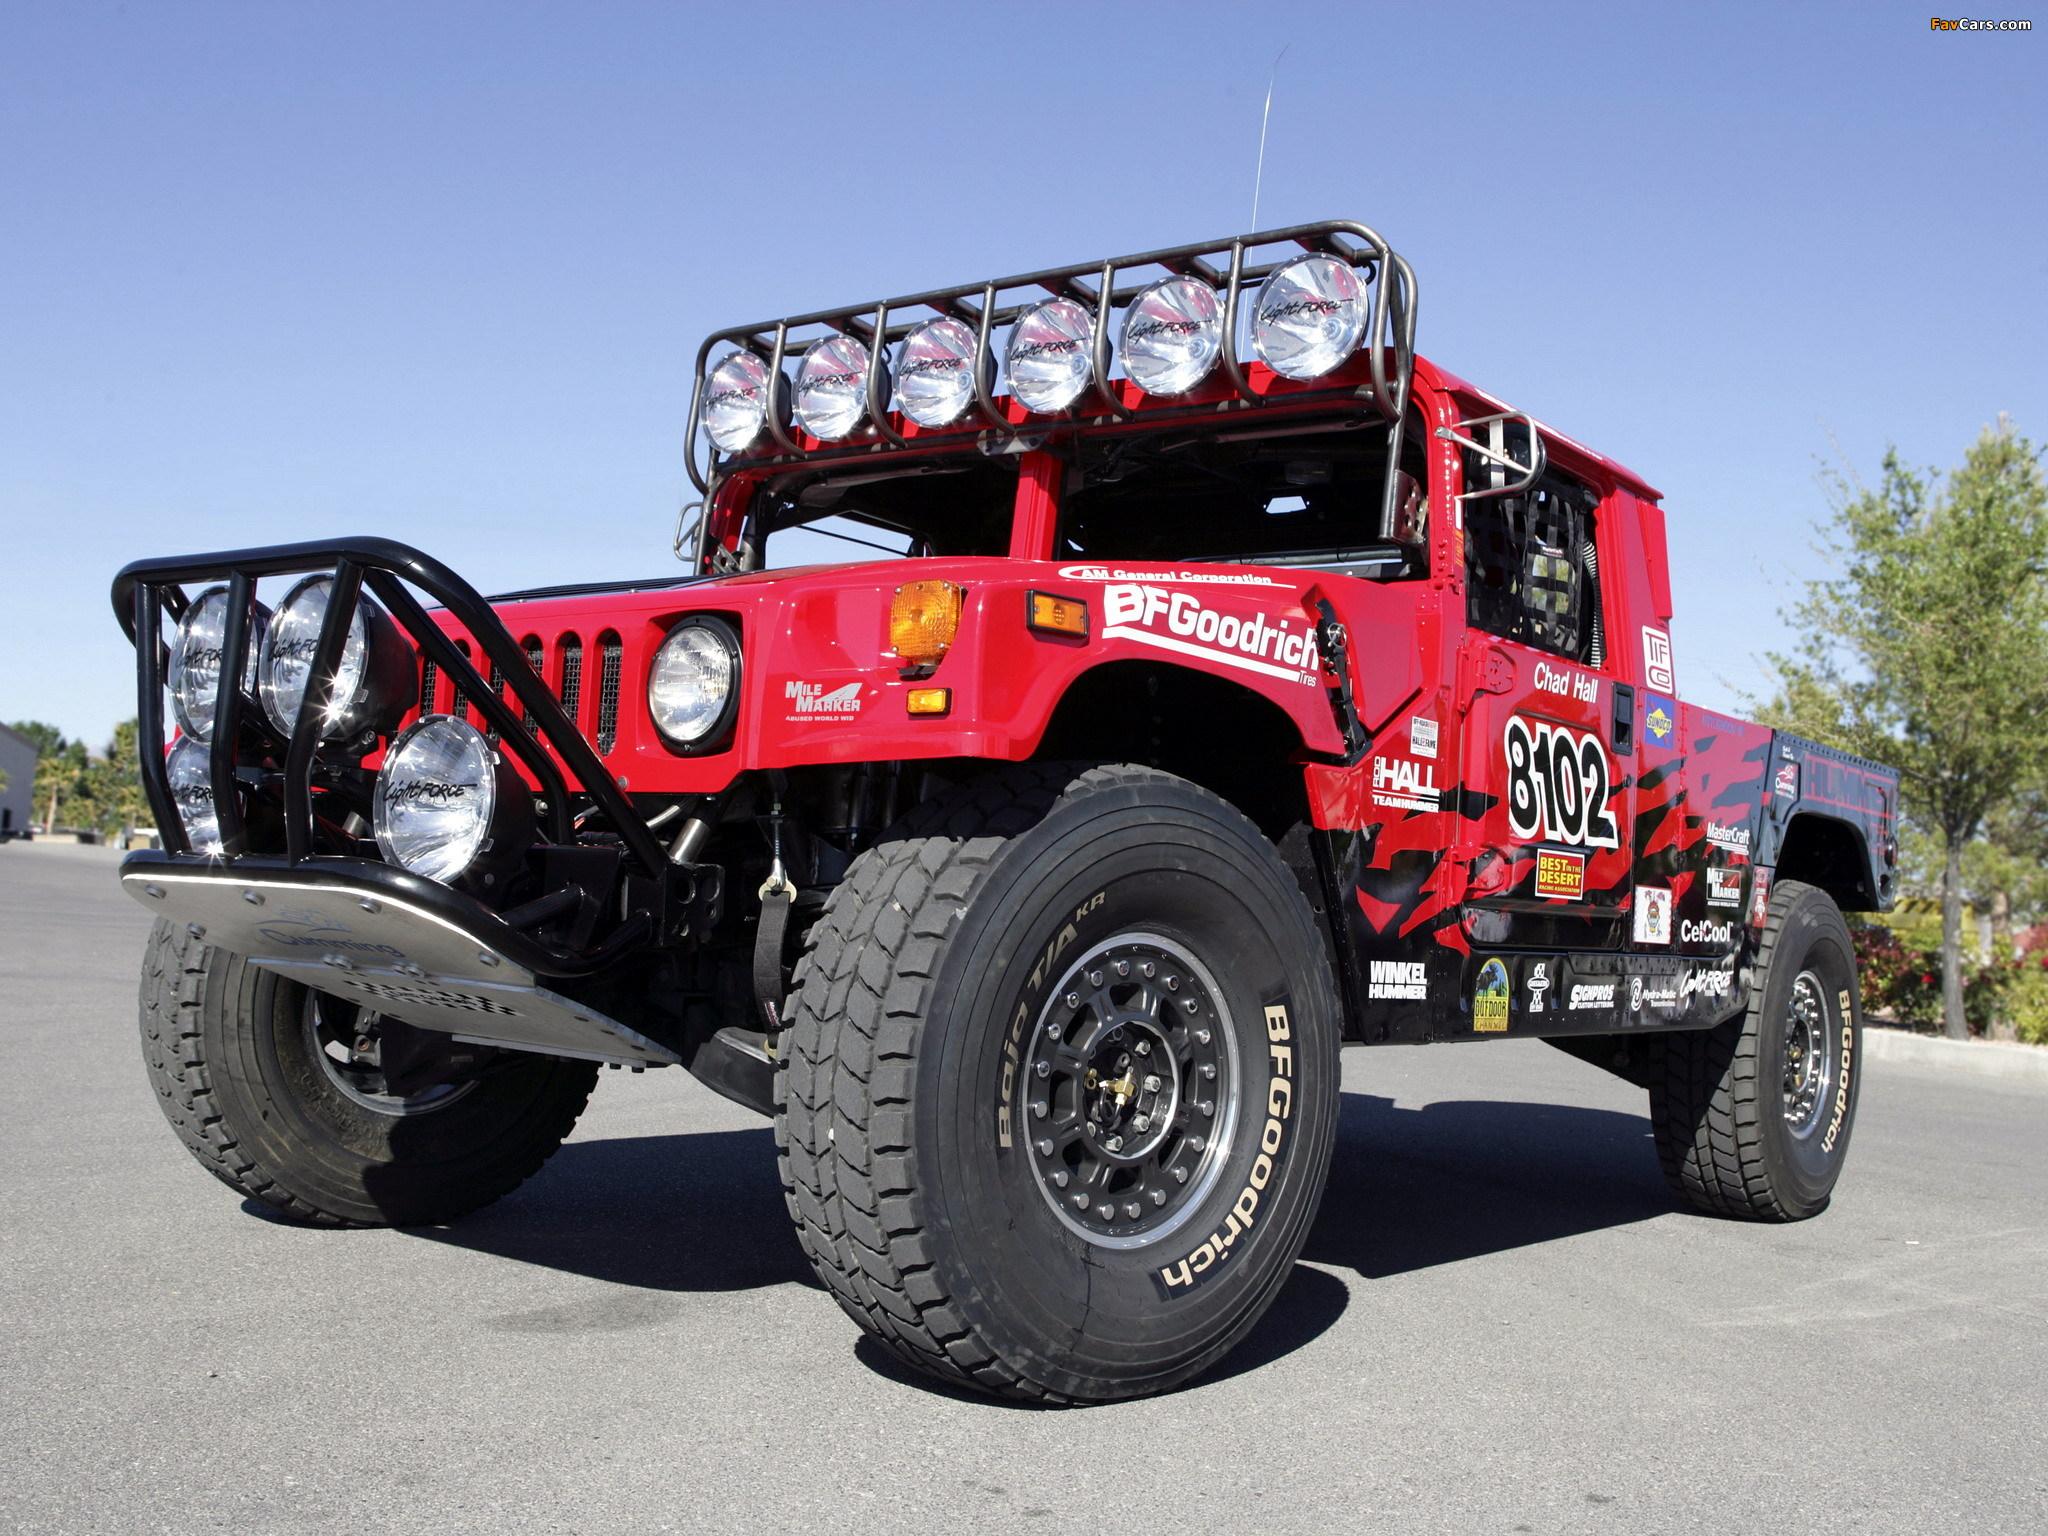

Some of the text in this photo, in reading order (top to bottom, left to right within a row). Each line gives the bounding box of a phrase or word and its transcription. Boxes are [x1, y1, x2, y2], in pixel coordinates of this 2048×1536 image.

[1081, 568, 1272, 584] AM General Corporation
[1103, 584, 1319, 671] BFGoodrich
[1300, 671, 1316, 687] Tires
[1534, 661, 1598, 703] Chad Hall
[796, 697, 860, 712] MARKER
[1647, 713, 1672, 733] SUNOCO
[1373, 756, 1381, 788] ROD
[1380, 756, 1440, 797] HALL
[1504, 715, 1619, 848] 8102
[384, 780, 477, 810] LightFORCE
[1372, 795, 1439, 813] TEAM HUMMER
[1706, 822, 1750, 845] MasterCraft
[1540, 856, 1568, 872] BEST
[1540, 870, 1581, 886] DESERT
[1711, 882, 1740, 899] MARKER
[1681, 919, 1732, 943] CelCool
[1370, 960, 1428, 985] WINKEL
[1368, 983, 1427, 1000] HUMMER
[1475, 1000, 1507, 1017] OUTDOOR
[998, 1001, 1029, 1149] Baja
[1820, 989, 1853, 1154] BFGoodrich
[1161, 1004, 1295, 1289] BFGoodrich
